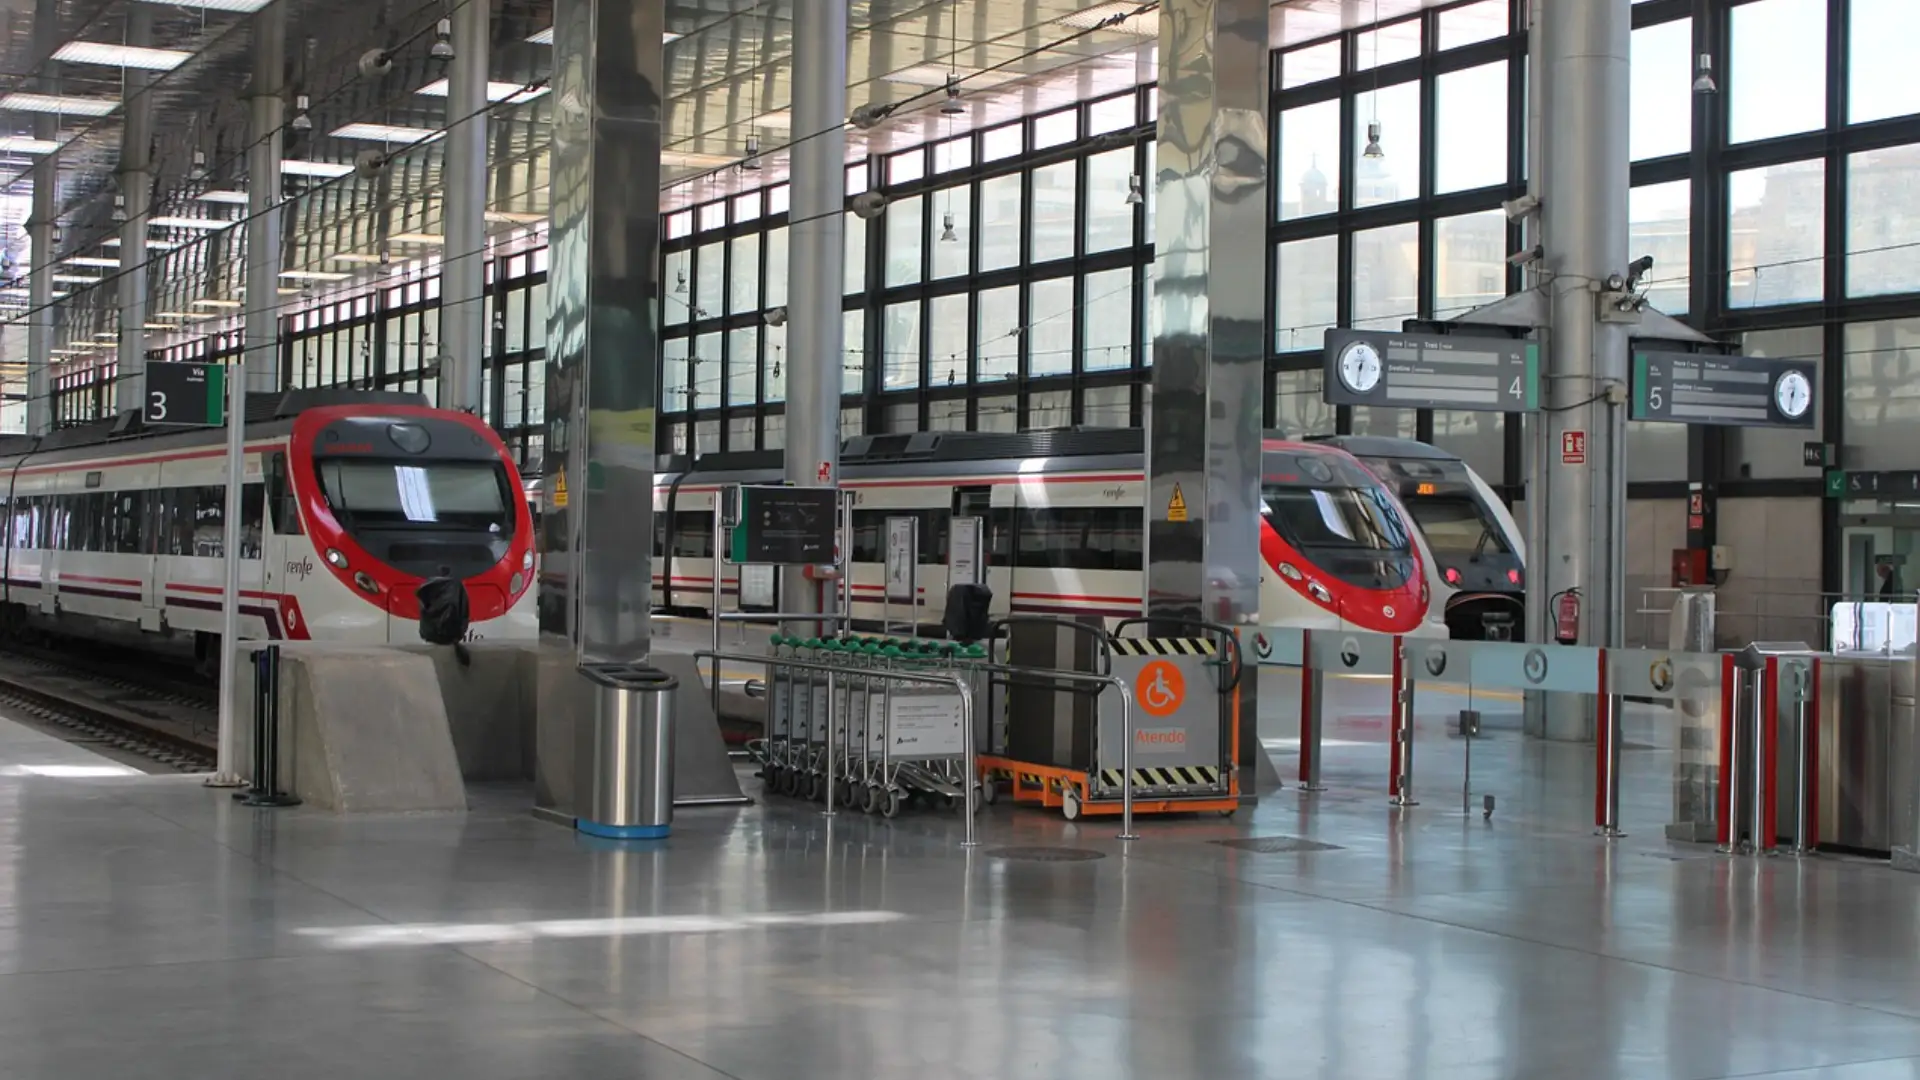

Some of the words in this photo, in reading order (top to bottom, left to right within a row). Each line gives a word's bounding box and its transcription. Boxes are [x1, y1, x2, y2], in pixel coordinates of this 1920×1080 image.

[1509, 376, 1523, 400] 4
[1649, 386, 1662, 410] 5
[150, 391, 167, 420] 3
[286, 555, 313, 582] renfe
[1134, 728, 1185, 745] Atendo
